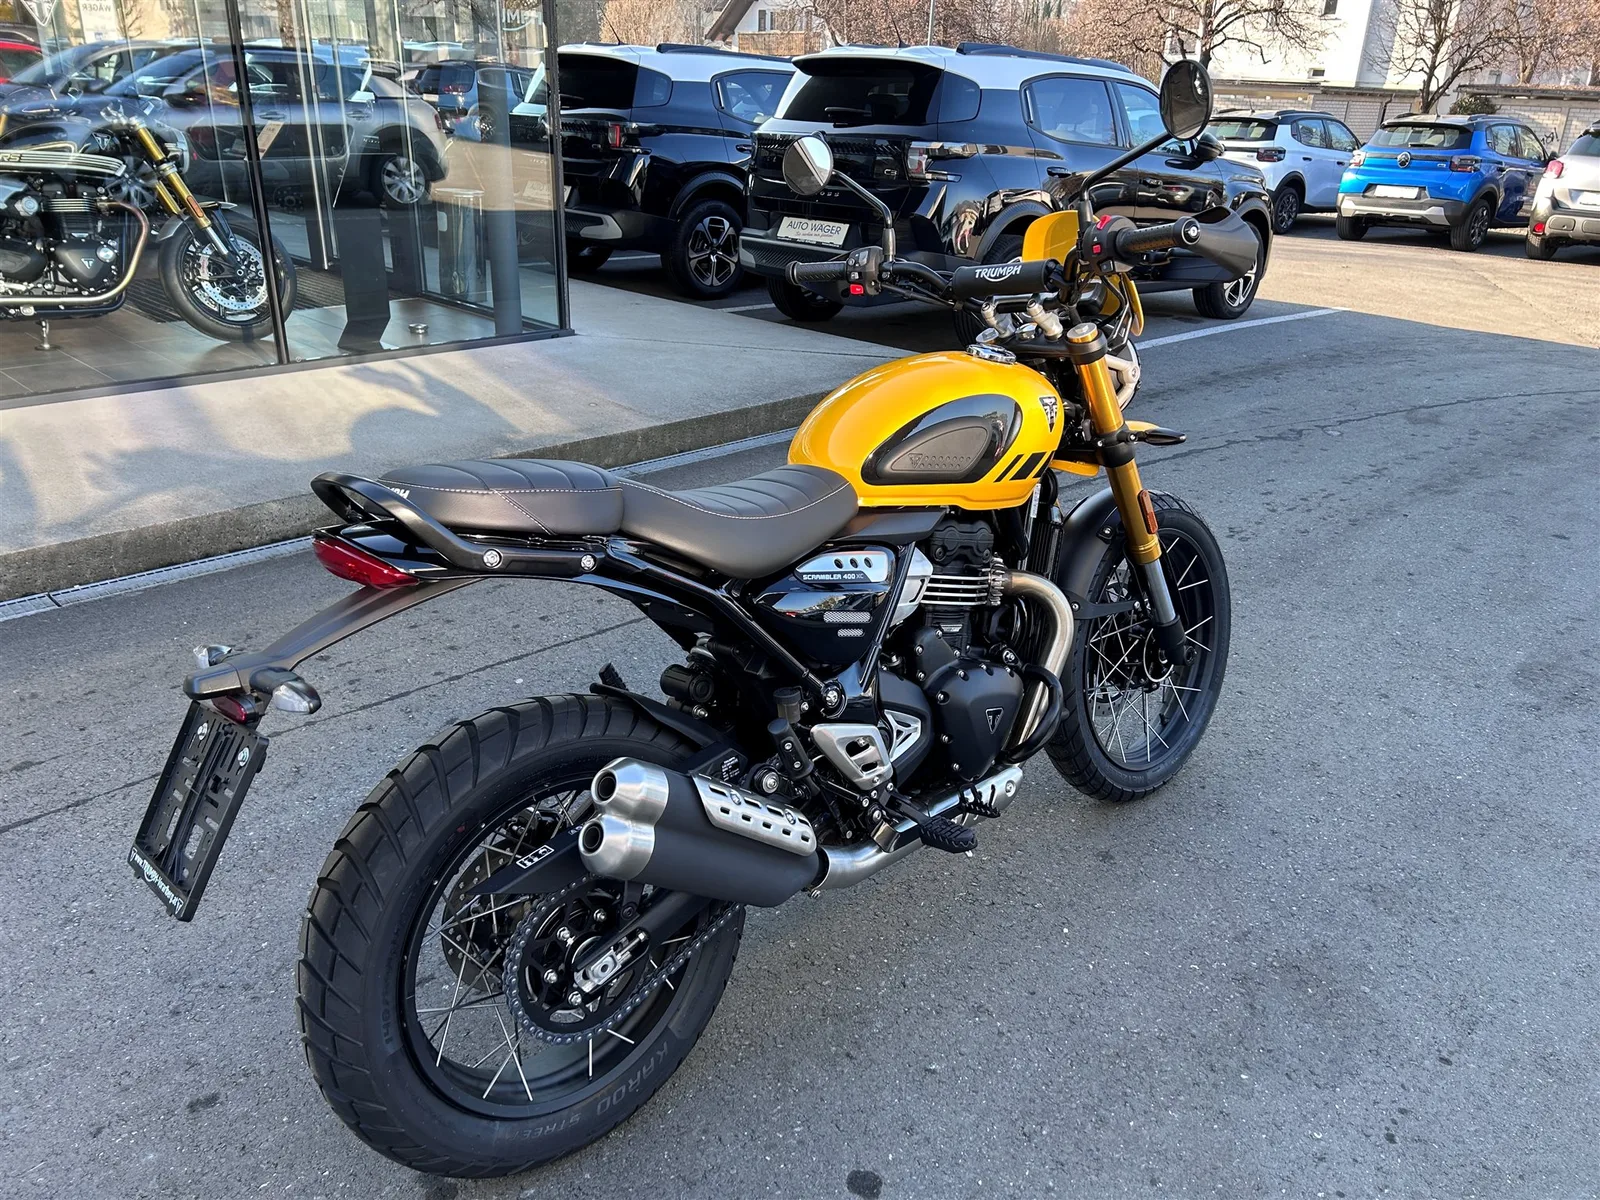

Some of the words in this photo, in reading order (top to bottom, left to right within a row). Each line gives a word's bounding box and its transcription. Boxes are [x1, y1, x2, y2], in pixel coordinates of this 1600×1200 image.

[787, 220, 809, 231] AUTO
[811, 222, 842, 235] WÄGER
[975, 264, 1022, 282] TRIUMPH
[596, 1041, 669, 1116] KAROO
